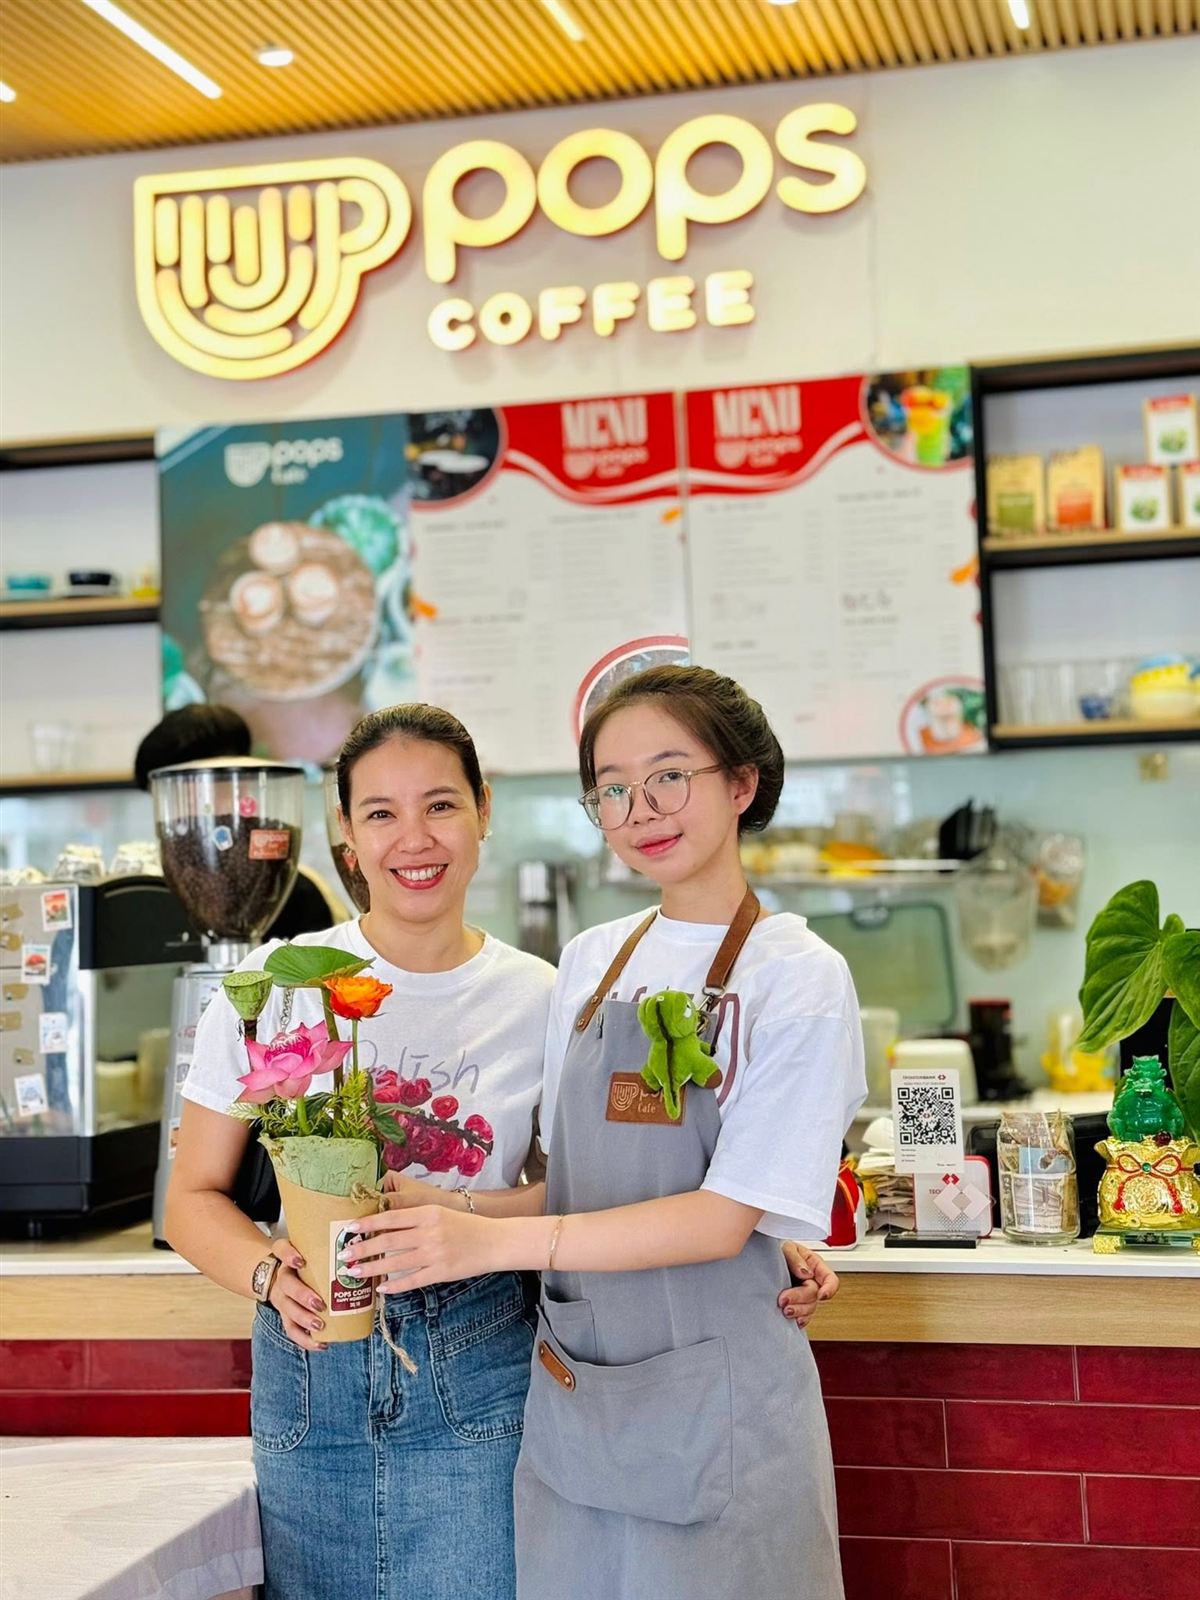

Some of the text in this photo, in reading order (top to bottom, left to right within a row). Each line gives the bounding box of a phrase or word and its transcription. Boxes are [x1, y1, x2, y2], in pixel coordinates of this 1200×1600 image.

[422, 102, 867, 284] pops
[428, 269, 755, 352] COFFEE
[561, 396, 647, 449] MENU
[713, 385, 801, 438] MENU
